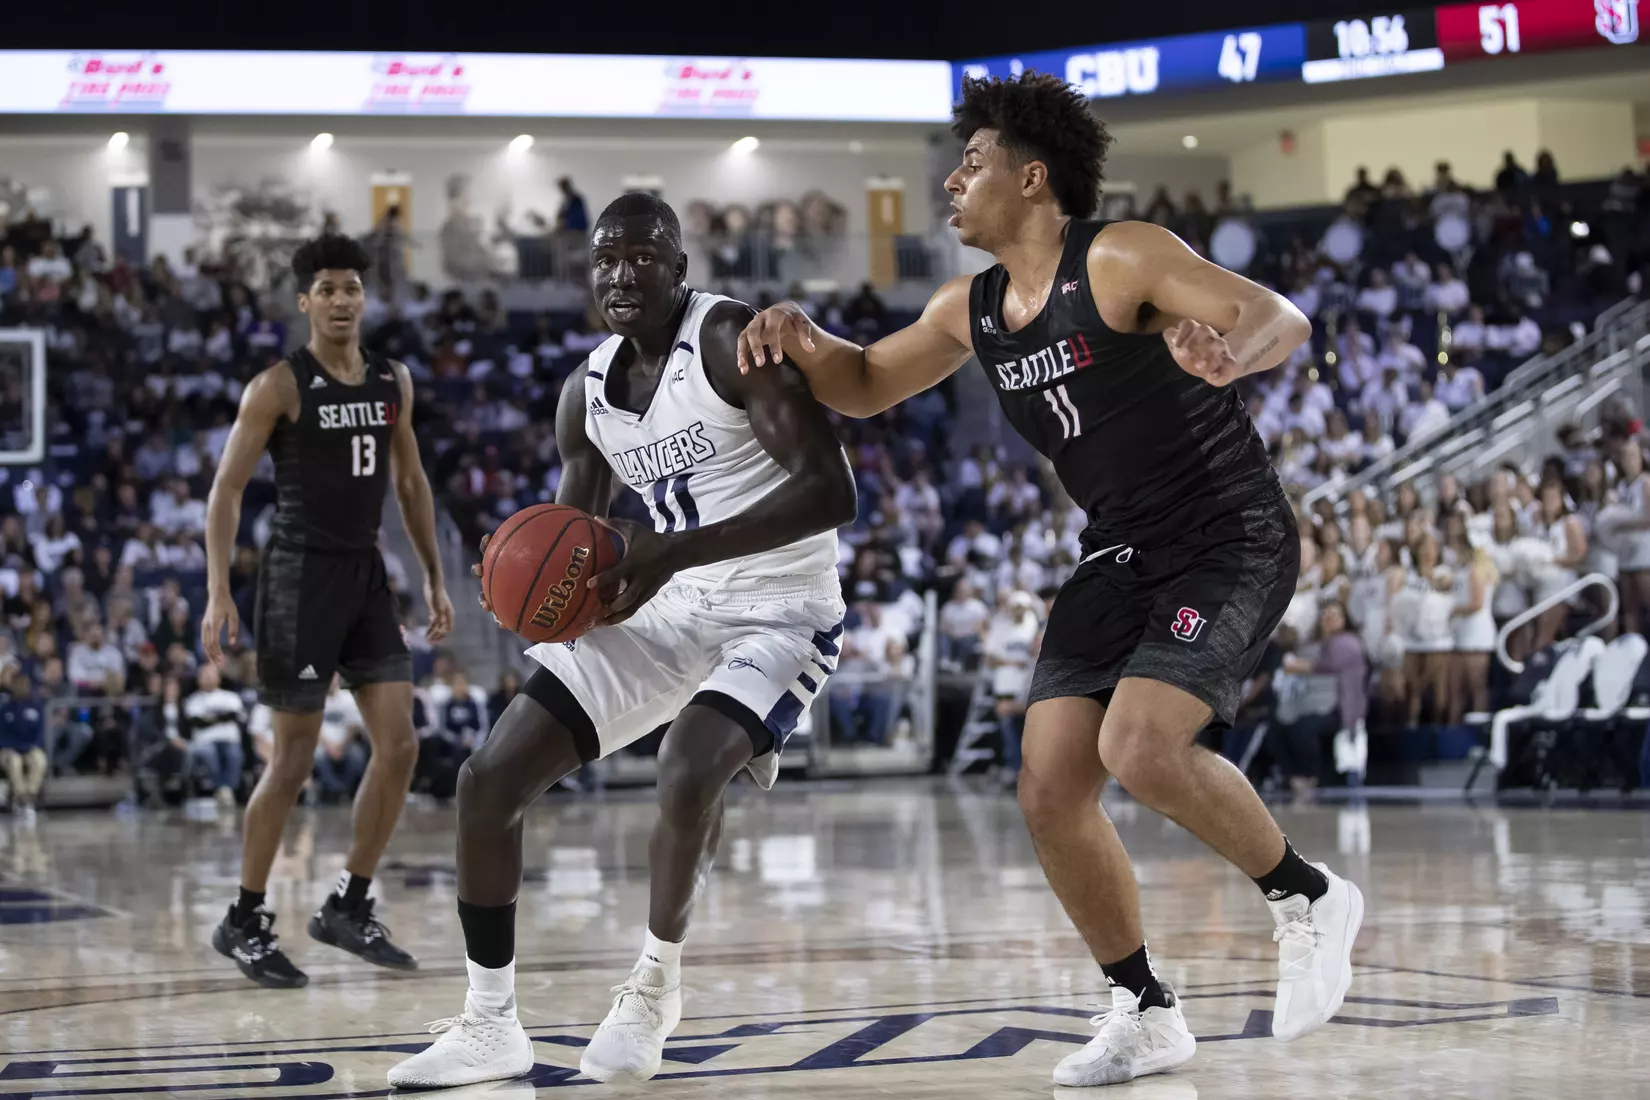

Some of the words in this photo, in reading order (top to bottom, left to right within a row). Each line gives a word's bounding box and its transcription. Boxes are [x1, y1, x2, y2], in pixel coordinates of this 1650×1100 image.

[1478, 3, 1520, 54] 51
[1065, 46, 1158, 97] CBU
[1218, 32, 1262, 83] 47
[1043, 384, 1082, 439] 11
[351, 434, 376, 477] 13
[612, 421, 716, 486] LANCERS
[529, 545, 590, 629] Wilson
